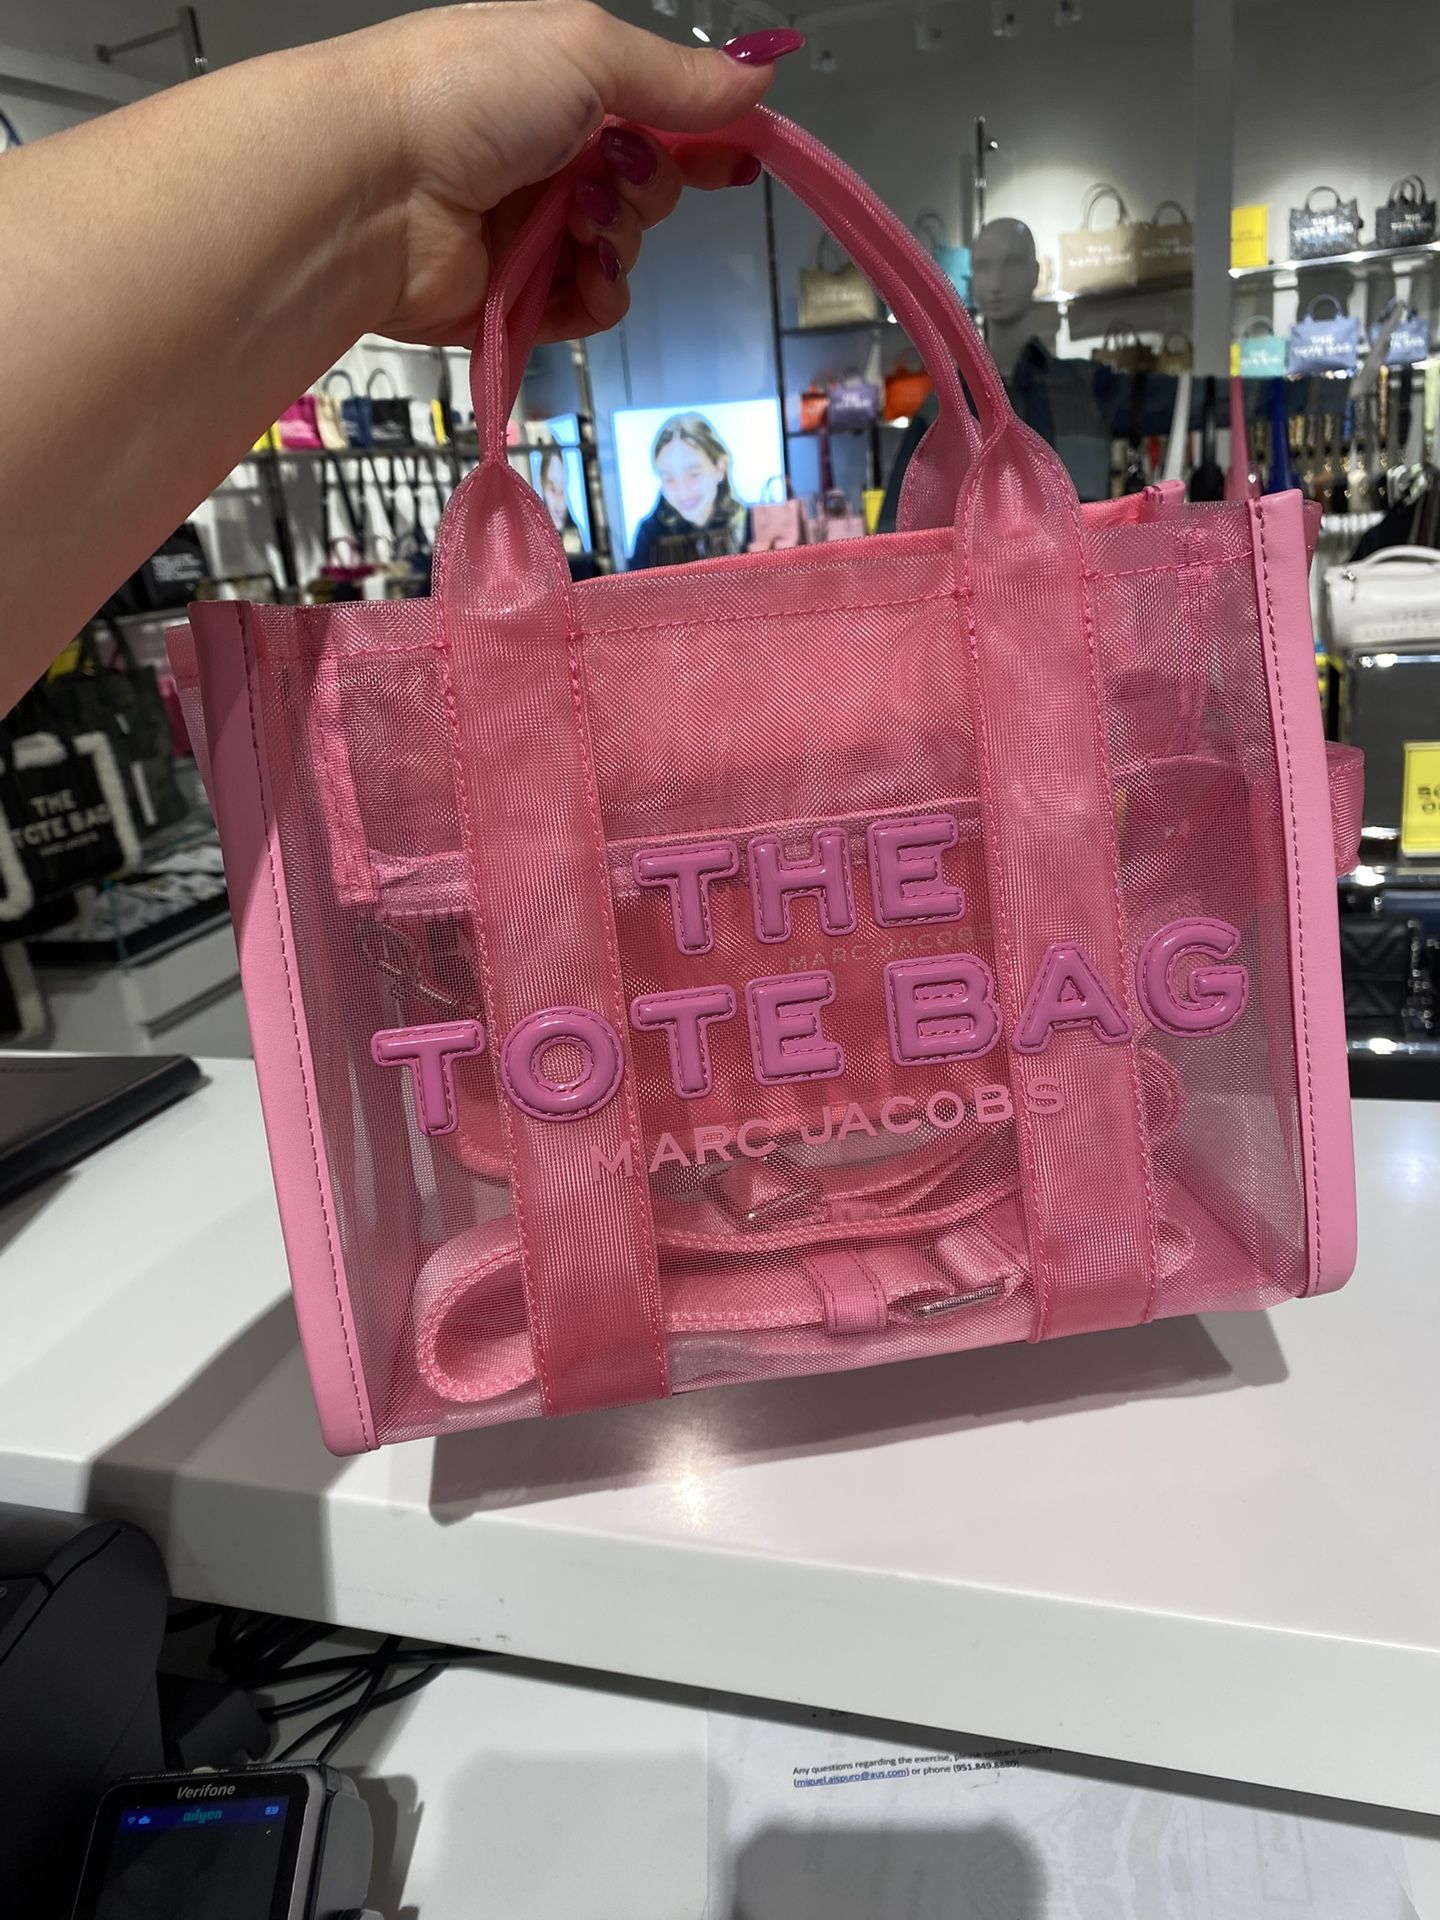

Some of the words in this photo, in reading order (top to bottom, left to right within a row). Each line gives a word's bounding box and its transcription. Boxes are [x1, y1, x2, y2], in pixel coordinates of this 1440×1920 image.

[632, 813, 966, 957] THE
[371, 968, 847, 1138] TOTE
[881, 916, 1251, 1069] BAG
[589, 1119, 778, 1182] MARC
[800, 1076, 1066, 1146] JACOBS
[176, 1784, 236, 1800] Verifone
[792, 1767, 810, 1775] Any
[811, 1762, 853, 1774] questions
[855, 1758, 896, 1769] regarding
[898, 1754, 912, 1764] the
[911, 1767, 921, 1776] or
[923, 1765, 951, 1776] phone
